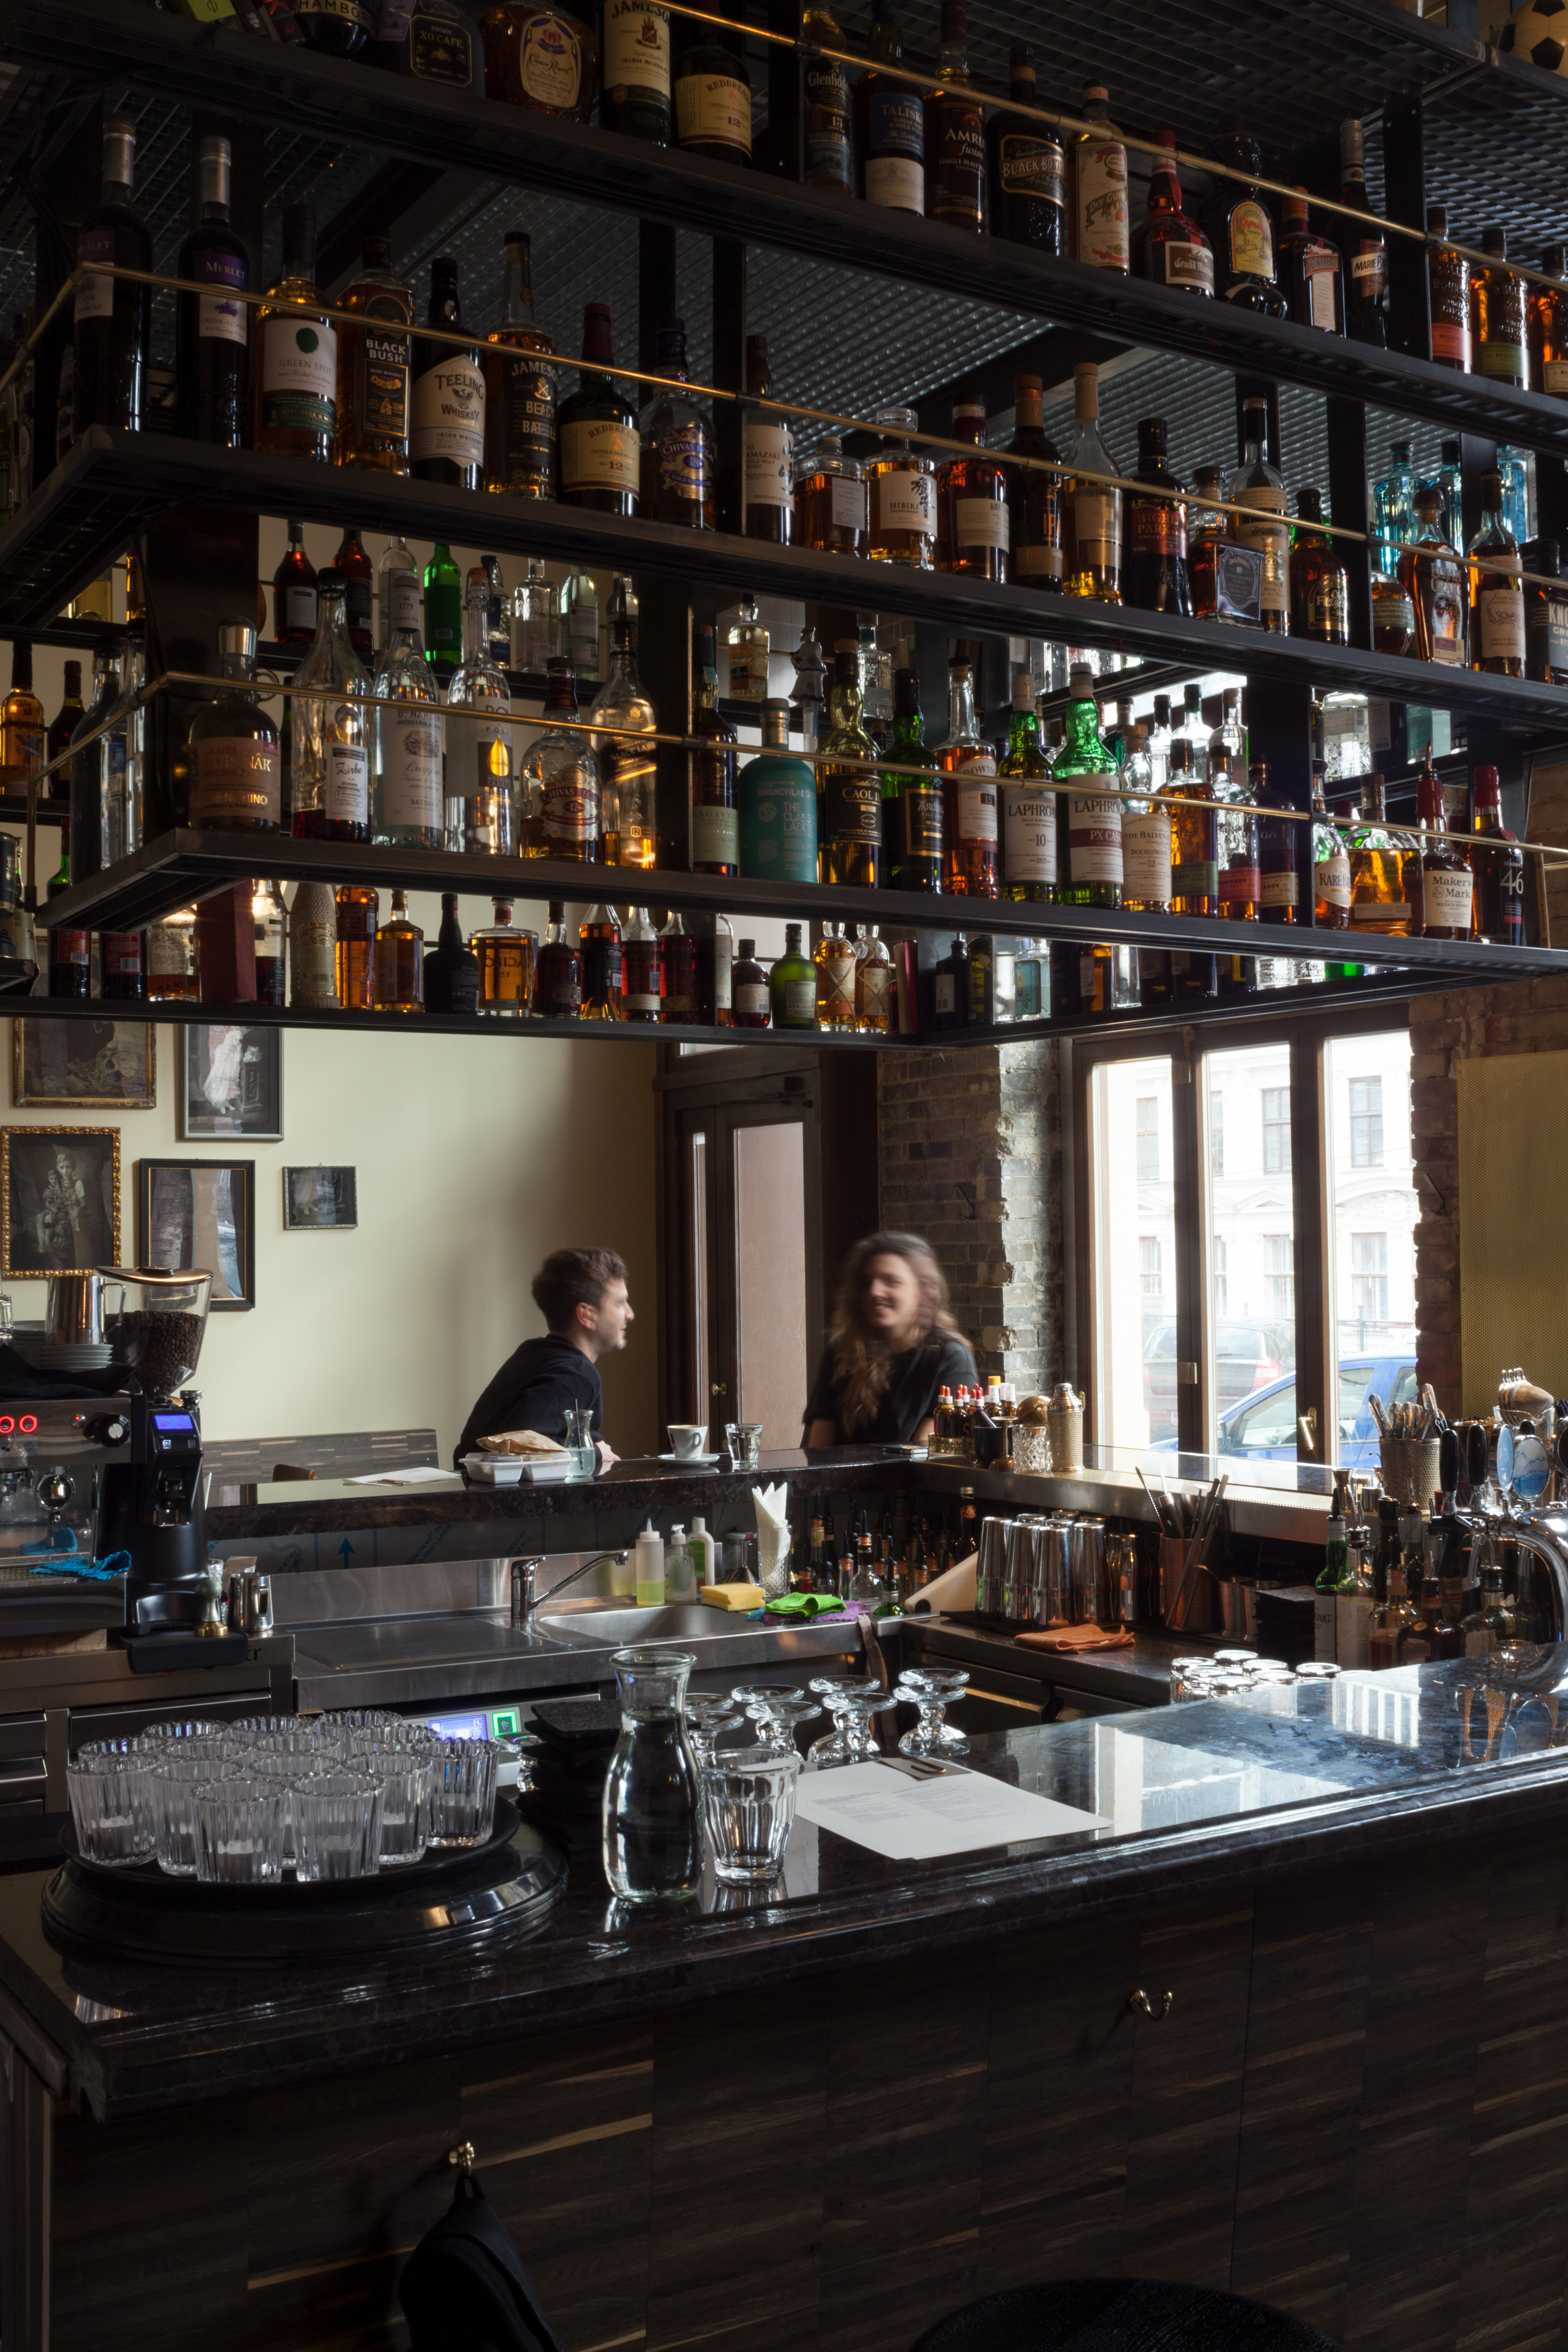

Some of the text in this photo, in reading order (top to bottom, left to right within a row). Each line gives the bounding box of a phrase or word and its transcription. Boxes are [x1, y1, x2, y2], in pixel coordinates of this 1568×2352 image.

[289, 0, 376, 28] CHAMBOR
[612, 1, 670, 27] JAMESO
[420, 31, 434, 41] XO
[529, 53, 573, 75] Crown Royal
[645, 59, 669, 75] WHISKEY
[706, 80, 750, 105] REDBREAST
[881, 104, 923, 125] TALISK
[727, 116, 740, 128] 12
[831, 116, 843, 128] 15
[946, 128, 986, 152] AMRU
[959, 143, 983, 160] fusion
[964, 160, 978, 168] MALT
[1001, 160, 1040, 178] BLACK
[1090, 197, 1104, 212] Dry
[1174, 258, 1196, 269] Grand
[1307, 258, 1338, 272] COINTREAU
[1355, 258, 1376, 272] MARIE
[206, 261, 245, 279] MERLET
[366, 339, 406, 355] BLACK
[369, 349, 403, 364] BUSH
[279, 359, 333, 376] GREEN SPOT
[435, 374, 484, 400] TEELING
[282, 409, 317, 418] MITCHELL
[441, 404, 480, 421] WHISKEY
[526, 400, 555, 419] BLACK
[523, 420, 556, 441] BARREL
[588, 424, 637, 446] REDBREAST
[459, 434, 482, 446] WHISKEY
[663, 443, 694, 454] CHIVAS
[690, 456, 699, 467] 18
[746, 451, 780, 460] AMAZAKI
[609, 461, 624, 471] 12
[671, 474, 687, 482] GOLD
[1138, 524, 1170, 535] PARK
[1251, 526, 1282, 536] Willett
[1430, 562, 1462, 583] ELIJAH
[1431, 577, 1462, 596] CRAIG
[486, 726, 509, 735] POLI
[204, 746, 237, 756] GRAPPA
[611, 749, 636, 761] BLACK
[204, 769, 237, 778] RISERVA
[335, 762, 363, 775] Zirbe
[543, 788, 575, 800] CHIVAS
[842, 787, 873, 799] CAOL
[984, 795, 993, 804] 15
[570, 803, 579, 811] 12
[783, 802, 802, 812] THE
[549, 814, 567, 823] BLENDED
[784, 821, 813, 833] LADDIE
[1036, 834, 1046, 847] 10
[1091, 830, 1103, 840] PX
[1140, 831, 1170, 841] BALVENIE
[1320, 873, 1342, 886] RARE
[1432, 876, 1472, 887] Maker's
[1499, 868, 1524, 896] 46
[1445, 888, 1471, 899] Mark
